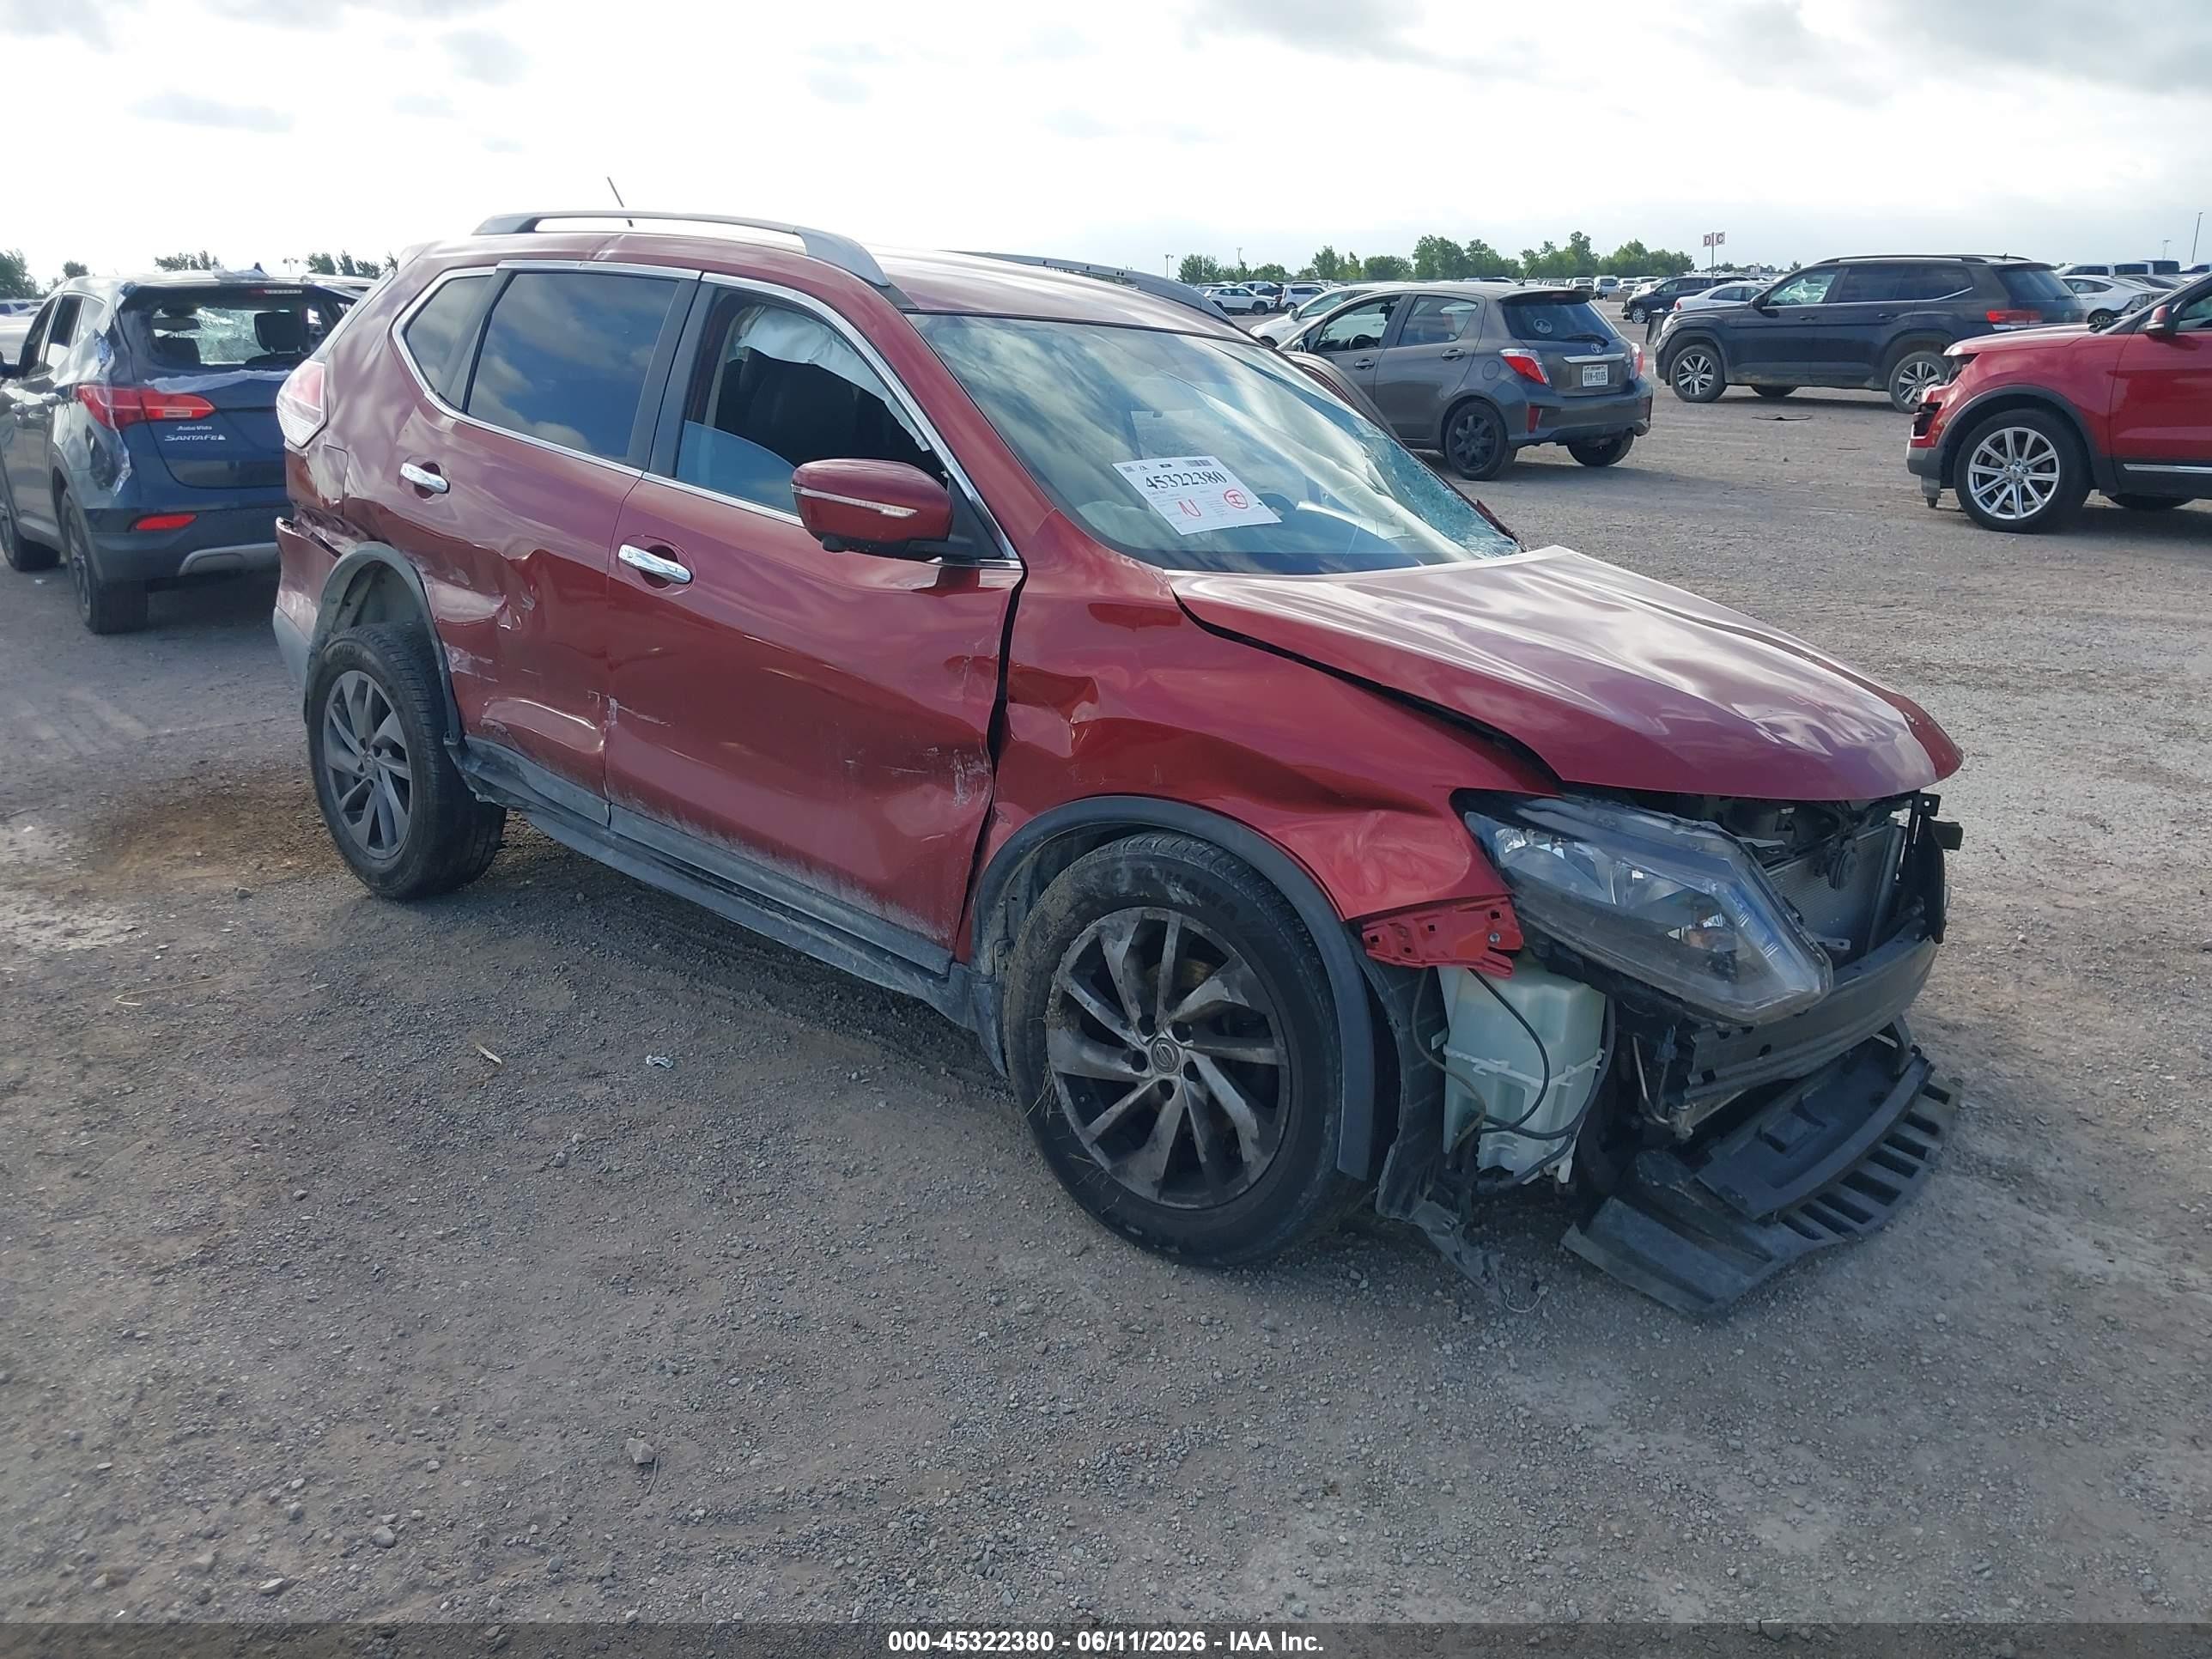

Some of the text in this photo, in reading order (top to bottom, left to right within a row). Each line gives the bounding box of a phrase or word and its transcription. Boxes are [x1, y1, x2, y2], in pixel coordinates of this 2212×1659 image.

[1705, 236, 1711, 246] D
[1717, 234, 1724, 244] C
[1145, 470, 1228, 489] 45322380
